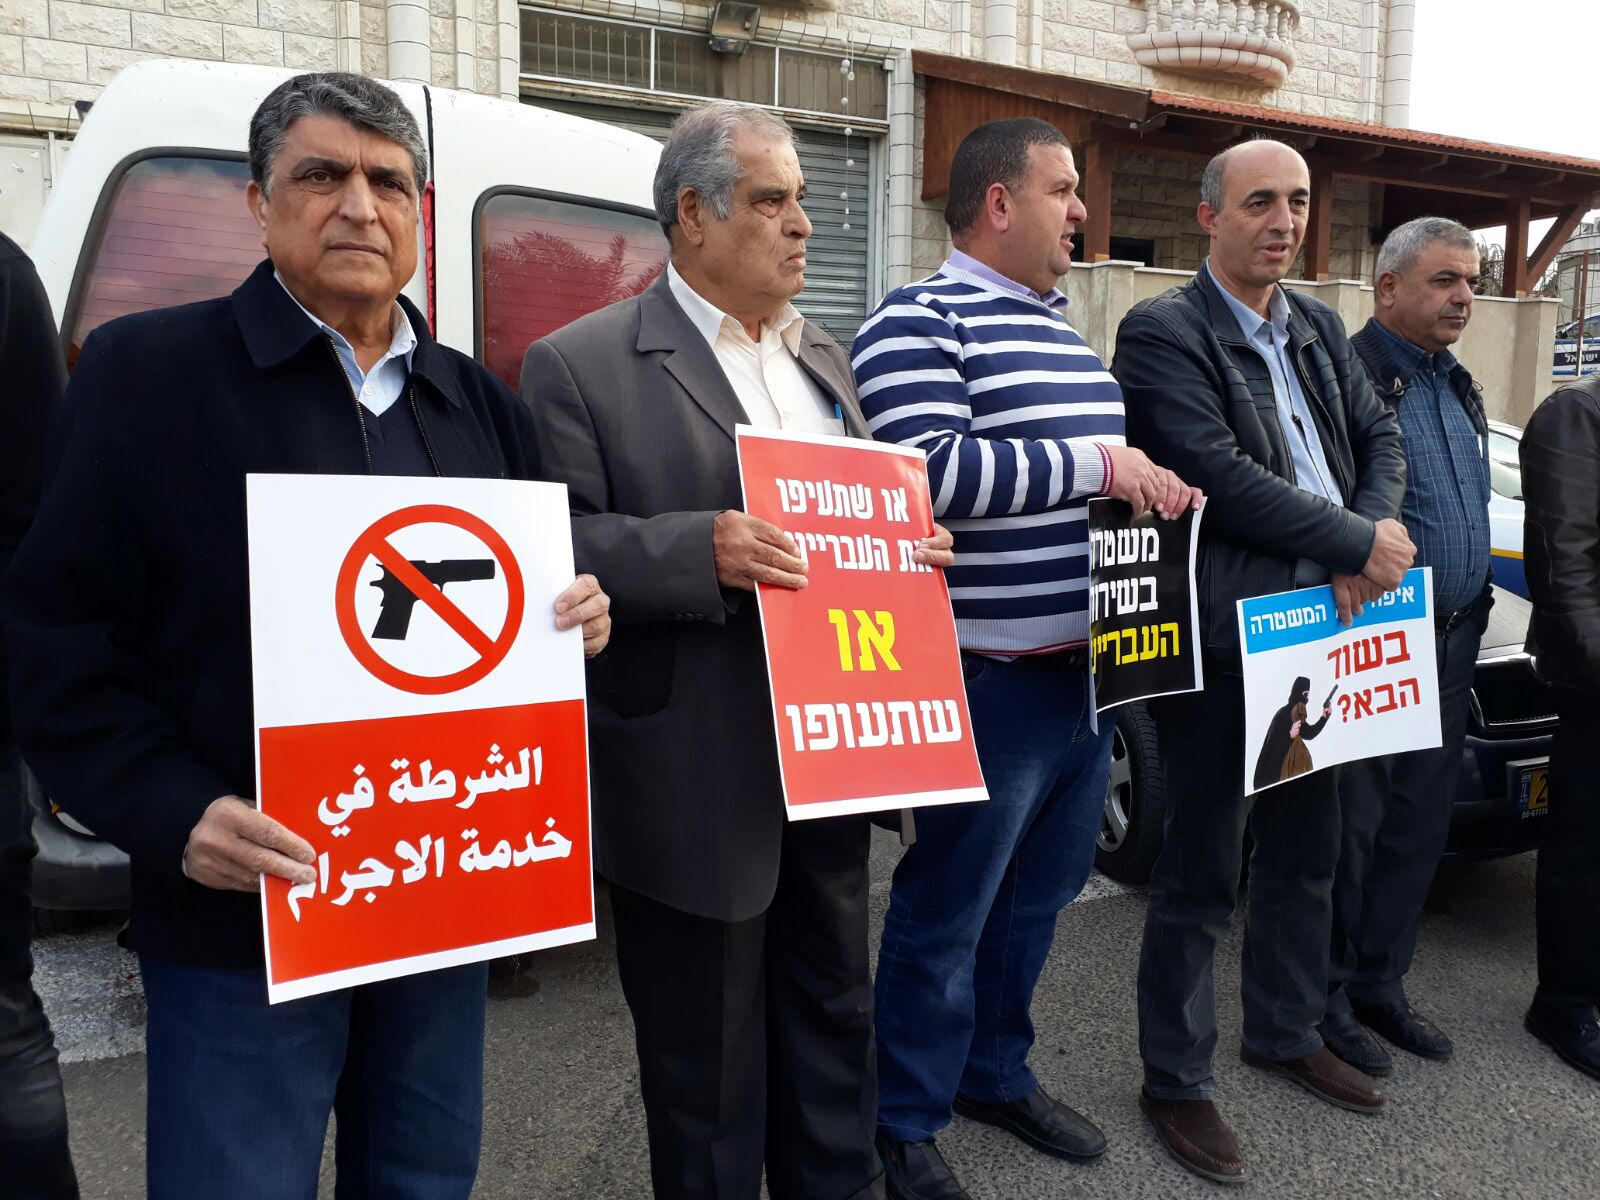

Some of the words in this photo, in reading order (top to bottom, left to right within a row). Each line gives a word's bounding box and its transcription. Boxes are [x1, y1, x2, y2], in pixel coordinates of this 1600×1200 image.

[774, 477, 874, 521] שתעיפו
[881, 487, 910, 523] או
[828, 608, 902, 672] או
[1250, 604, 1327, 635] המשטרה
[1327, 630, 1411, 680] בשוד
[785, 699, 963, 752] שתעופו
[1337, 677, 1421, 723] הבא?
[317, 763, 375, 837] في
[388, 743, 544, 810] الشرطة
[457, 816, 574, 874] خدمة
[286, 833, 445, 922] الاجرام
